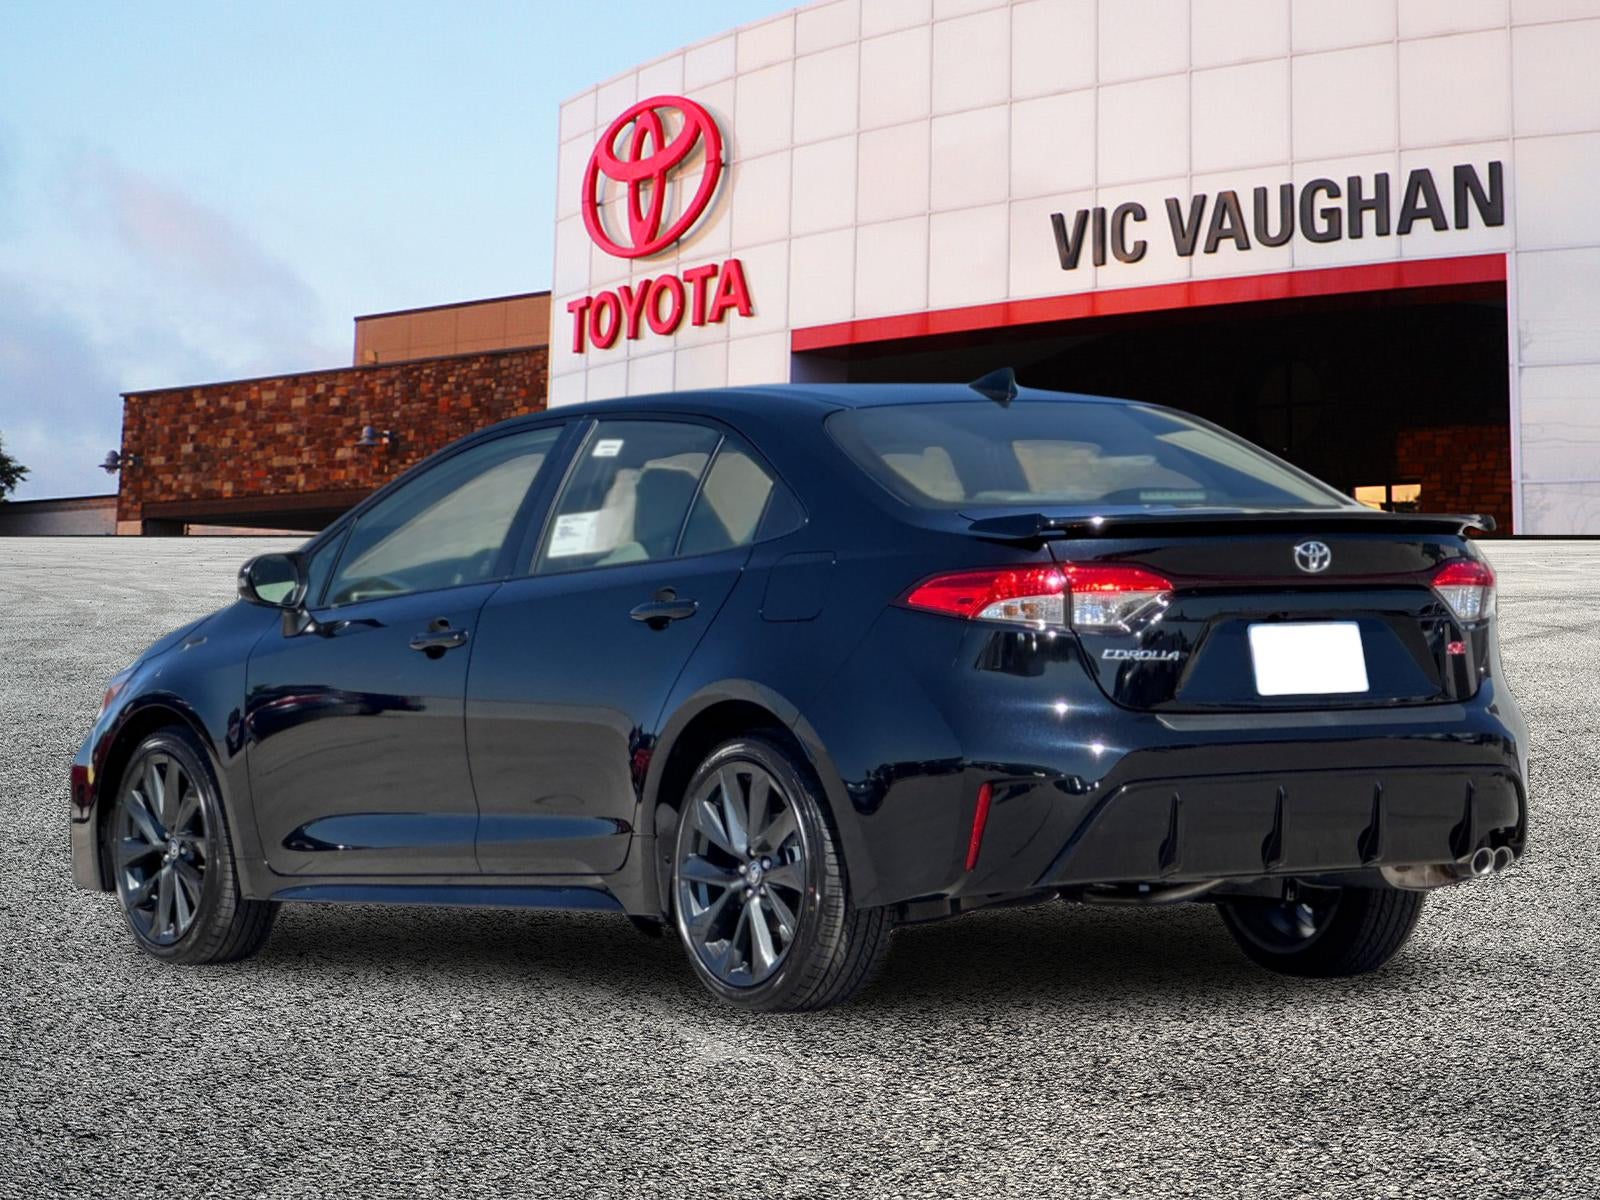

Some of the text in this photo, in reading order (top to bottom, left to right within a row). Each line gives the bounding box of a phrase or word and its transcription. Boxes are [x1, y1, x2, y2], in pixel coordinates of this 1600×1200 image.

[1050, 160, 1505, 271] VIC VAUGHAN
[567, 258, 754, 354] TOYOTA
[1101, 648, 1181, 661] COROLLA
